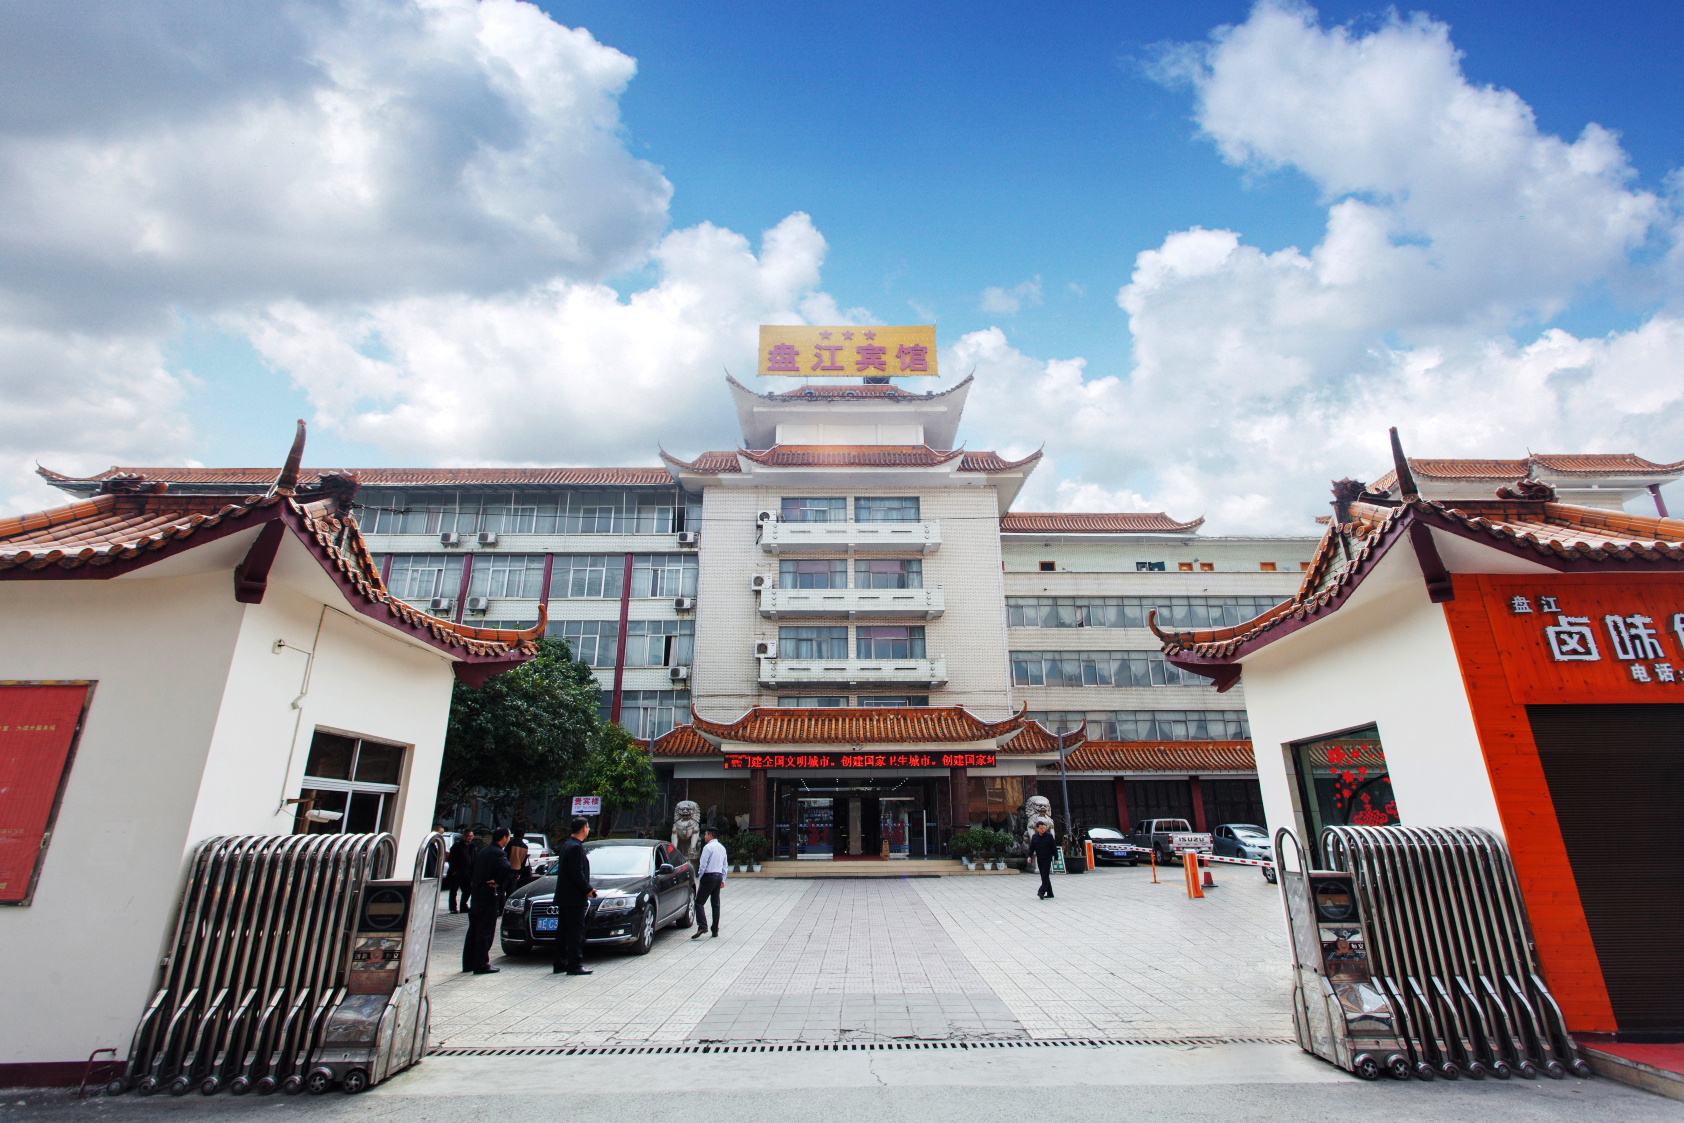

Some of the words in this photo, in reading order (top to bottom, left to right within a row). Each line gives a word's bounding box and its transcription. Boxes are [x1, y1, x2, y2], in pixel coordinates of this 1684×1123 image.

[767, 343, 928, 371] 盘江宾馆
[1511, 596, 1562, 613] 盘江
